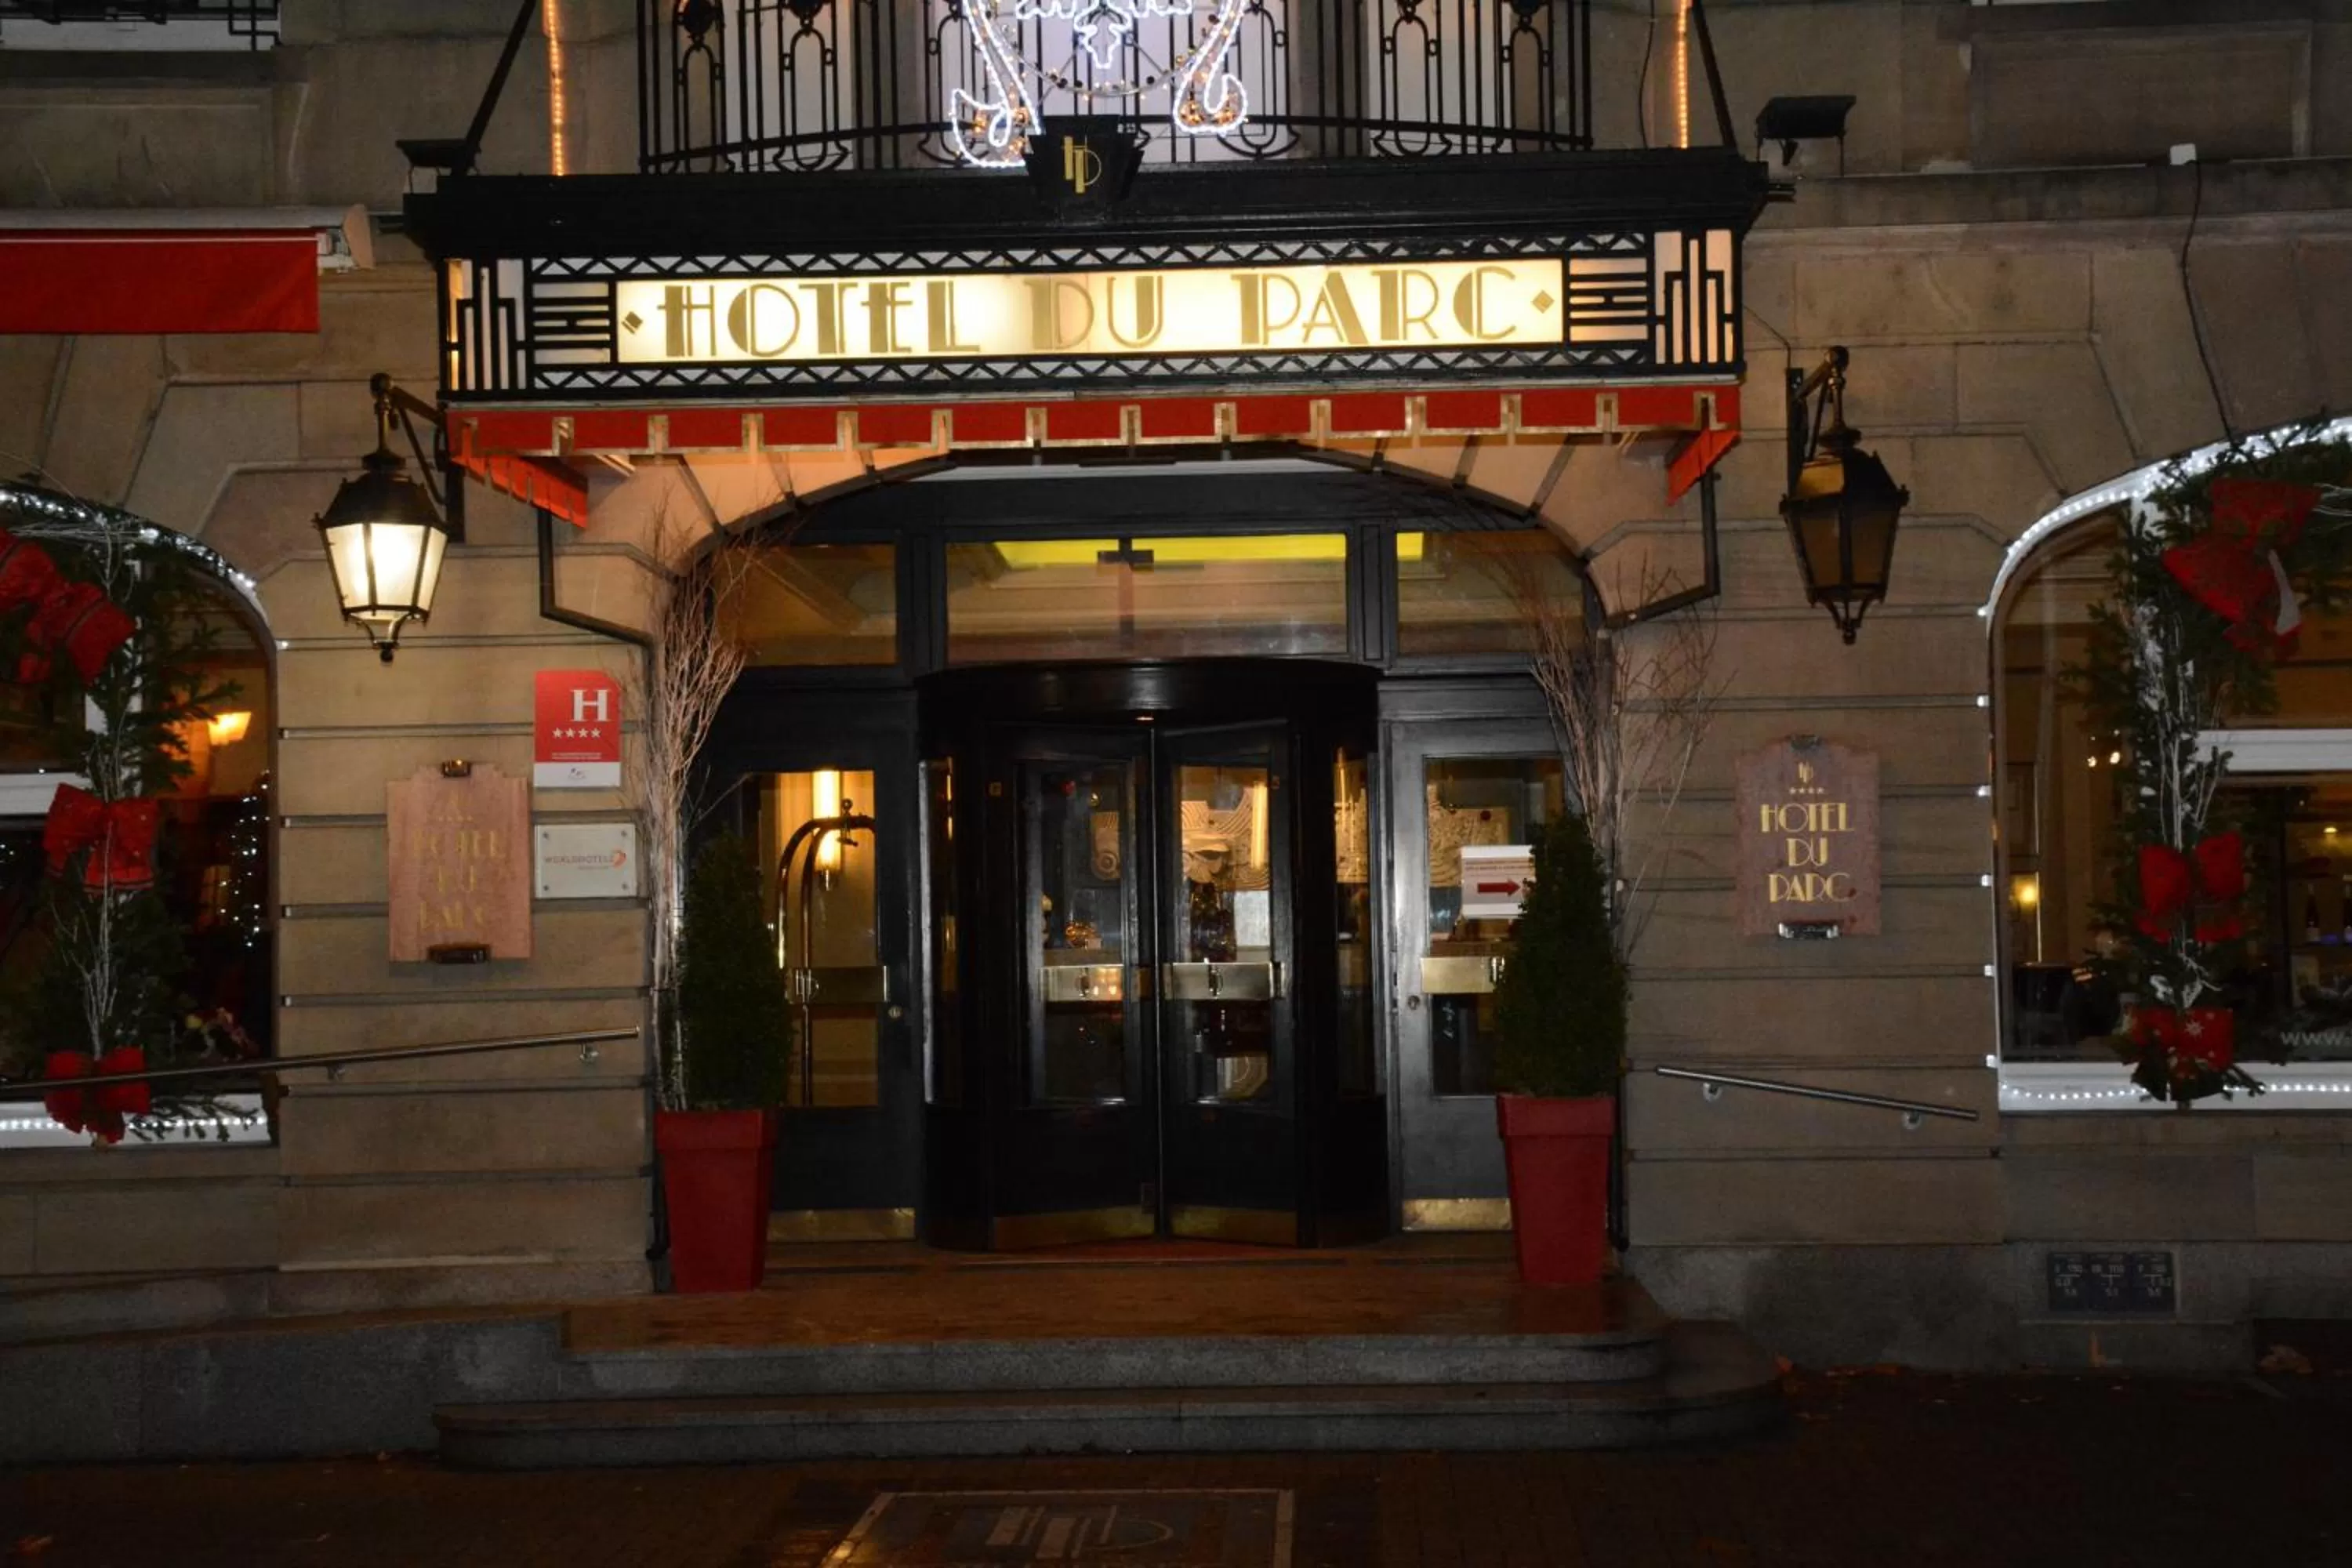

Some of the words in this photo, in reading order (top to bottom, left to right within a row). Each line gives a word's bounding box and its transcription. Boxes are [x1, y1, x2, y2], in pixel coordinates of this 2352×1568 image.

[657, 281, 981, 358] HOTEL
[1024, 274, 1164, 350] DU
[1231, 266, 1517, 344] PARC
[570, 688, 612, 722] H
[1760, 803, 1855, 833] HOTEL
[1786, 837, 1829, 866] DU
[1769, 873, 1851, 902] PARC
